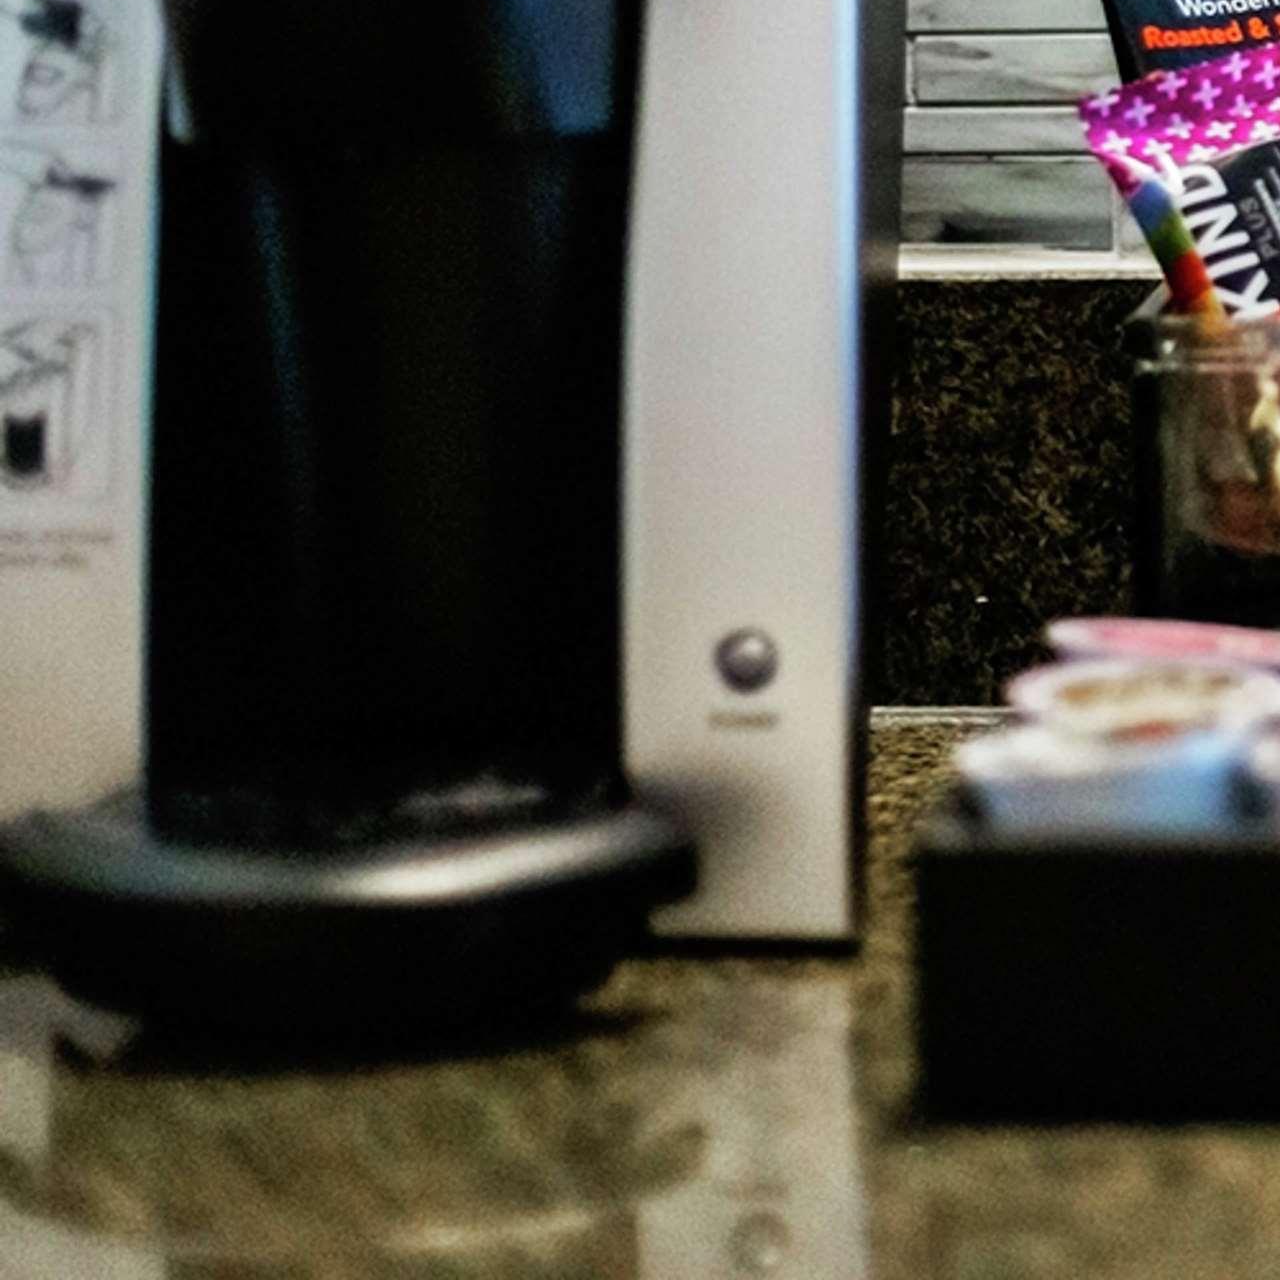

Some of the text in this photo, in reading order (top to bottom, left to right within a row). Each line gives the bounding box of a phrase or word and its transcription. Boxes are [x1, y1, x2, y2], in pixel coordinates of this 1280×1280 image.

[1142, 21, 1244, 50] Roasted
[1248, 17, 1271, 40] &
[1238, 195, 1280, 260] PLUS
